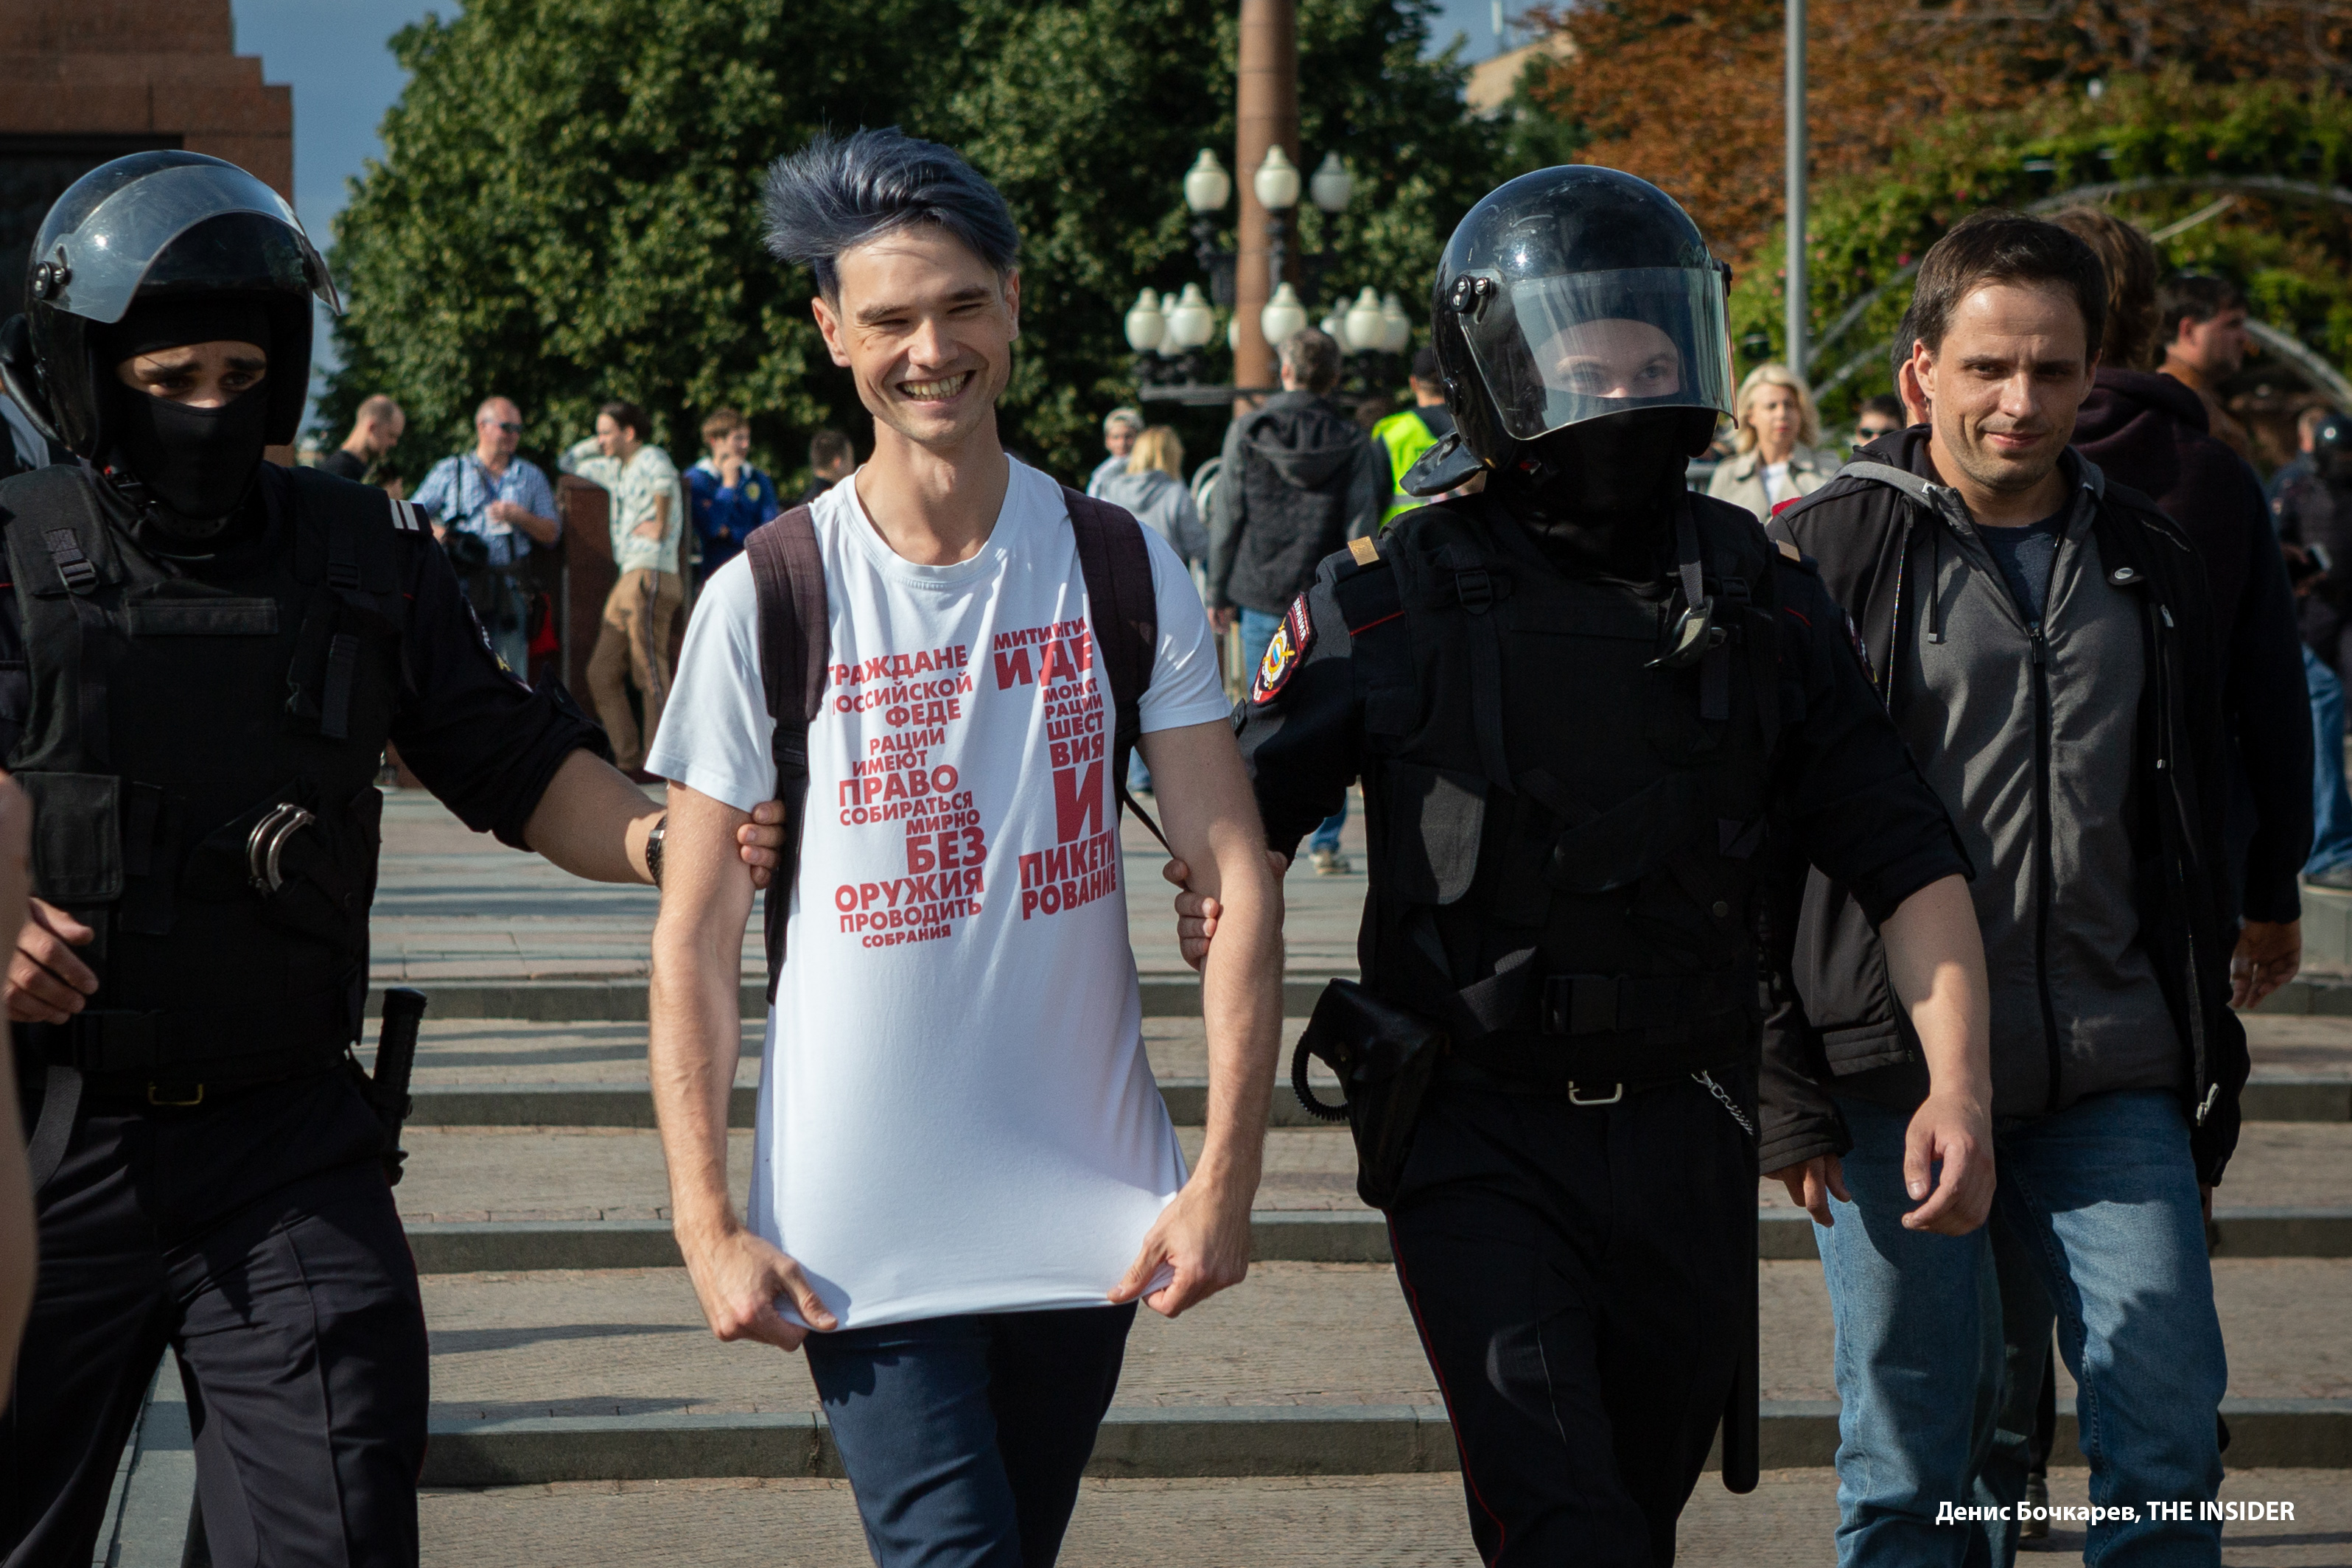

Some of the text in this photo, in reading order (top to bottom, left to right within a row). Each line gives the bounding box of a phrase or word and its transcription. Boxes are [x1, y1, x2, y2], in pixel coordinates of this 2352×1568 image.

[994, 617, 1088, 651] МИТИНГИ
[994, 631, 1093, 690] И ДЕ
[885, 698, 962, 728] ФЕДЕ
[1044, 695, 1103, 720] РАЦИИ
[869, 727, 945, 756] РАЦИИ
[1047, 711, 1104, 741] ШЕСТ
[852, 749, 928, 777] ИМЕЮТ
[1049, 732, 1105, 768] ВИЯ
[839, 764, 959, 808] ПРАВО
[1053, 760, 1104, 844] И
[839, 791, 973, 827] СОБИРАТЬСЯ
[906, 808, 981, 836] МИРНО
[906, 826, 987, 875] БЕЗ
[1018, 827, 1114, 889] ПИКЕТИ
[834, 866, 984, 913] ОРУЖИЯ
[1022, 864, 1116, 920] РОВАНИЕ
[839, 897, 982, 934] ПРОВОДИТЬ
[862, 924, 951, 948] СОБРАНИЯ
